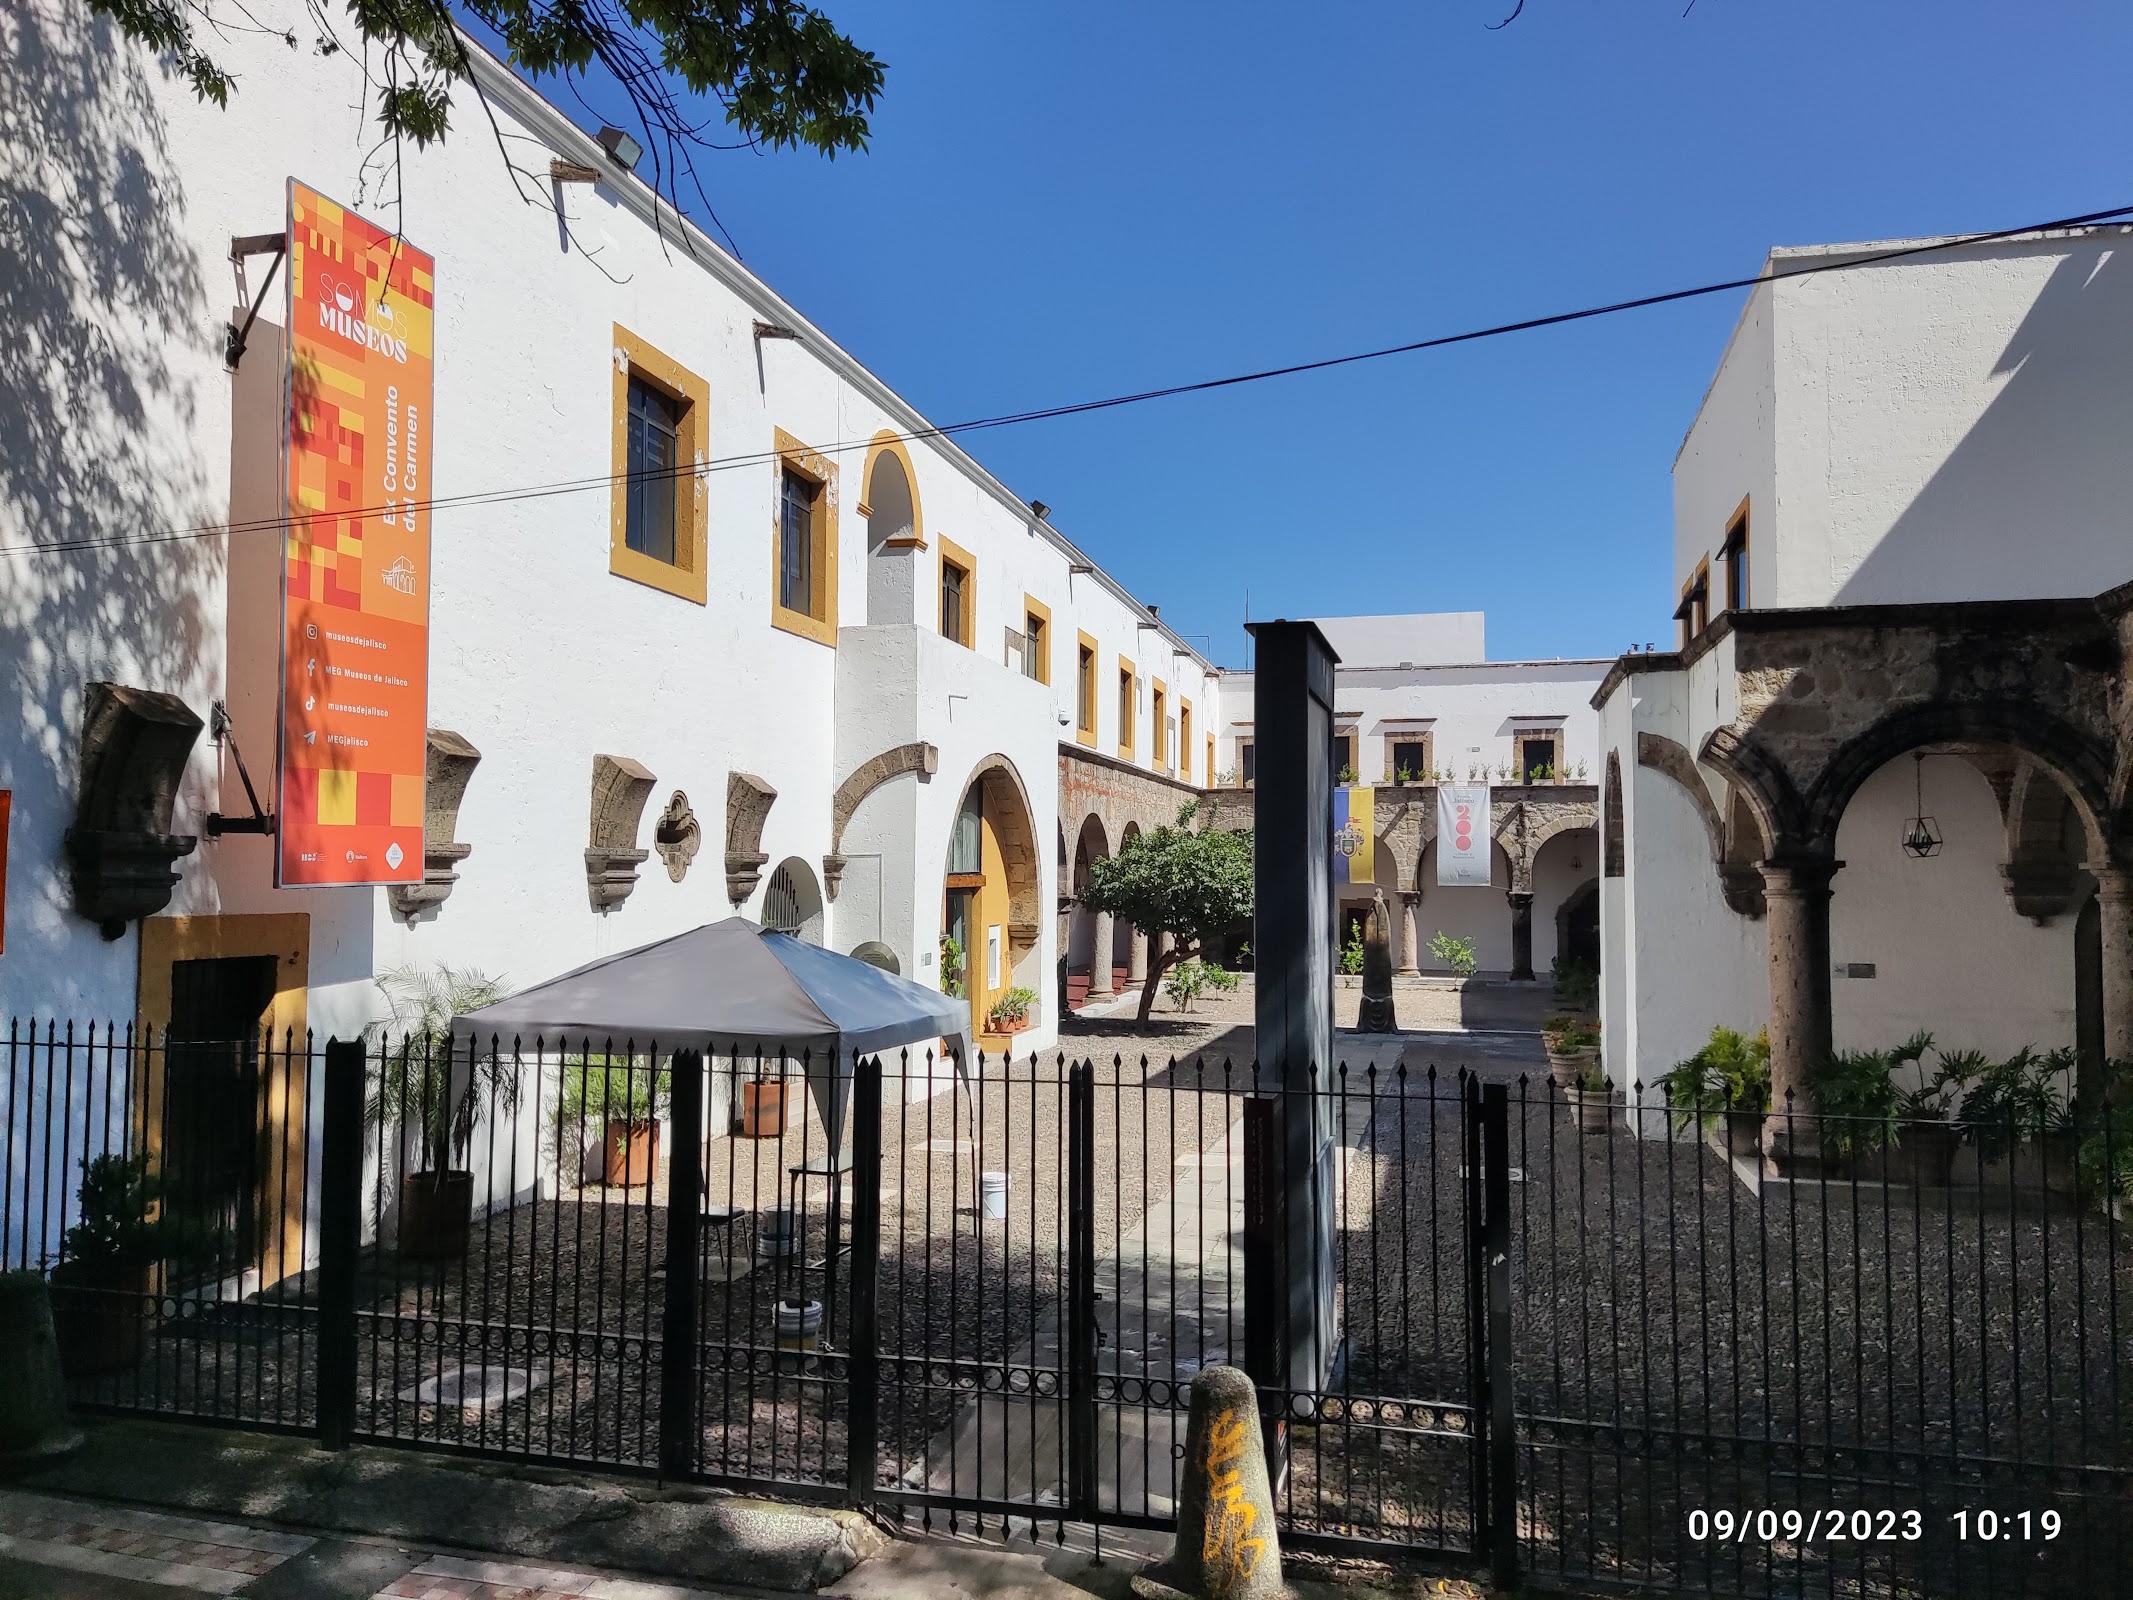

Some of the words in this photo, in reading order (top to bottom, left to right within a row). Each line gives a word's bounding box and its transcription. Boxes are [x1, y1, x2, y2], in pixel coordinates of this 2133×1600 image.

[319, 273, 408, 340] SOMOS
[319, 302, 408, 364] MUSEOS
[383, 385, 398, 492] Convento
[403, 404, 418, 491] Carmen
[383, 498, 396, 526] Ex
[403, 496, 416, 533] del
[325, 631, 387, 650] museosdejalisco
[325, 665, 342, 676] MEG
[344, 668, 372, 681] Museos
[373, 674, 383, 683] de
[384, 675, 409, 687] Jalisco
[327, 703, 389, 717] museosdejalisco
[327, 734, 369, 747] MEGjalisco
